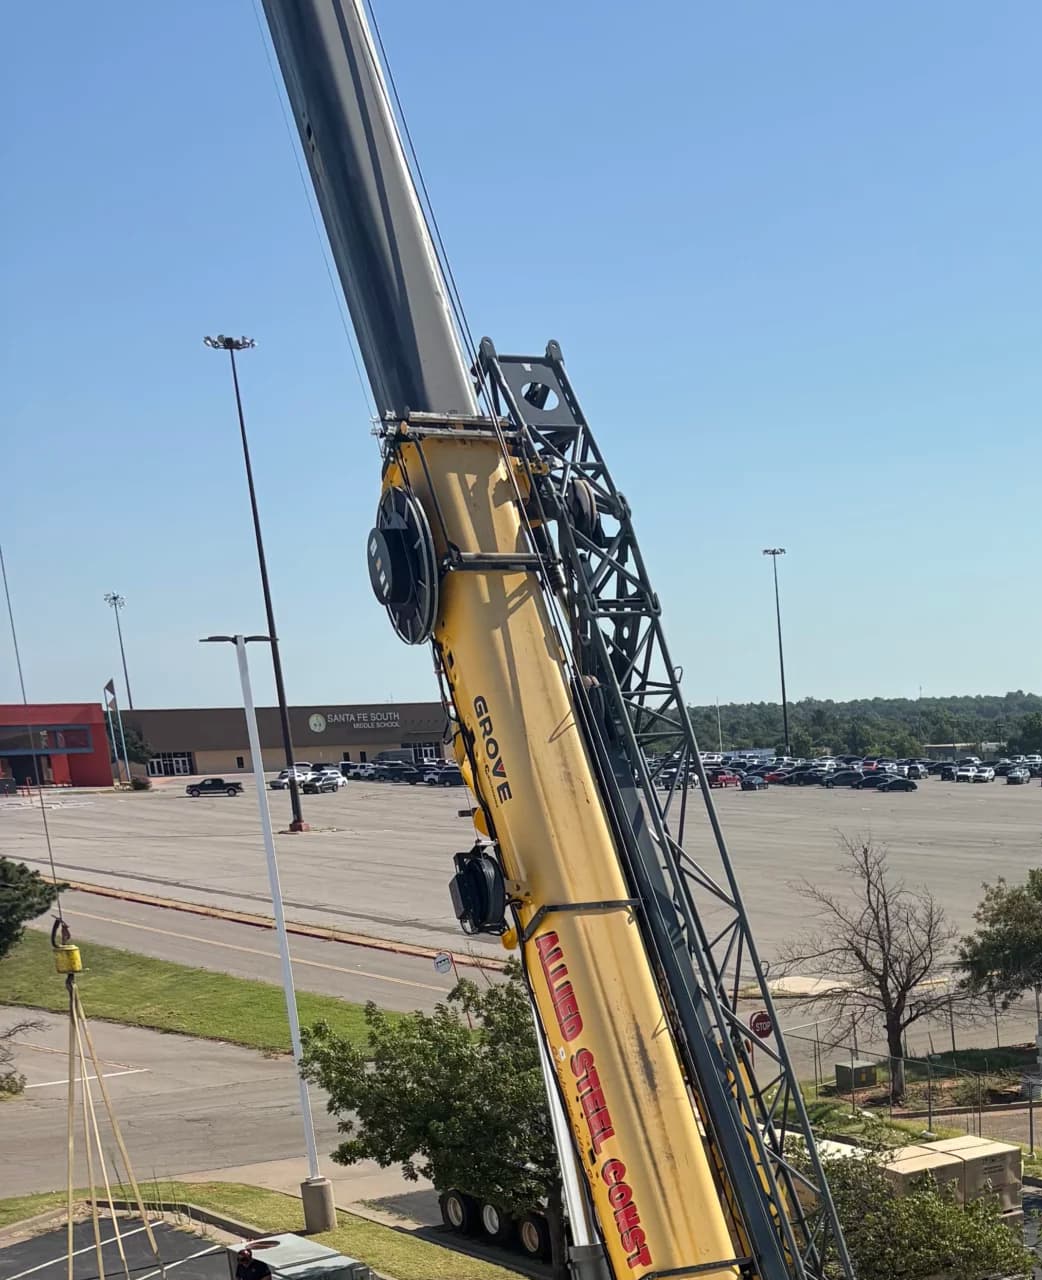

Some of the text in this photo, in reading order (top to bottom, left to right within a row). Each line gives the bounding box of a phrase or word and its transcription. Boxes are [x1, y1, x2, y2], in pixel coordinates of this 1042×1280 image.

[327, 711, 400, 723] SANTA FE SOUTH
[473, 695, 513, 804] GROVE
[756, 1021, 770, 1033] STOP
[535, 930, 654, 1270] ALLIED STEEL CONST
